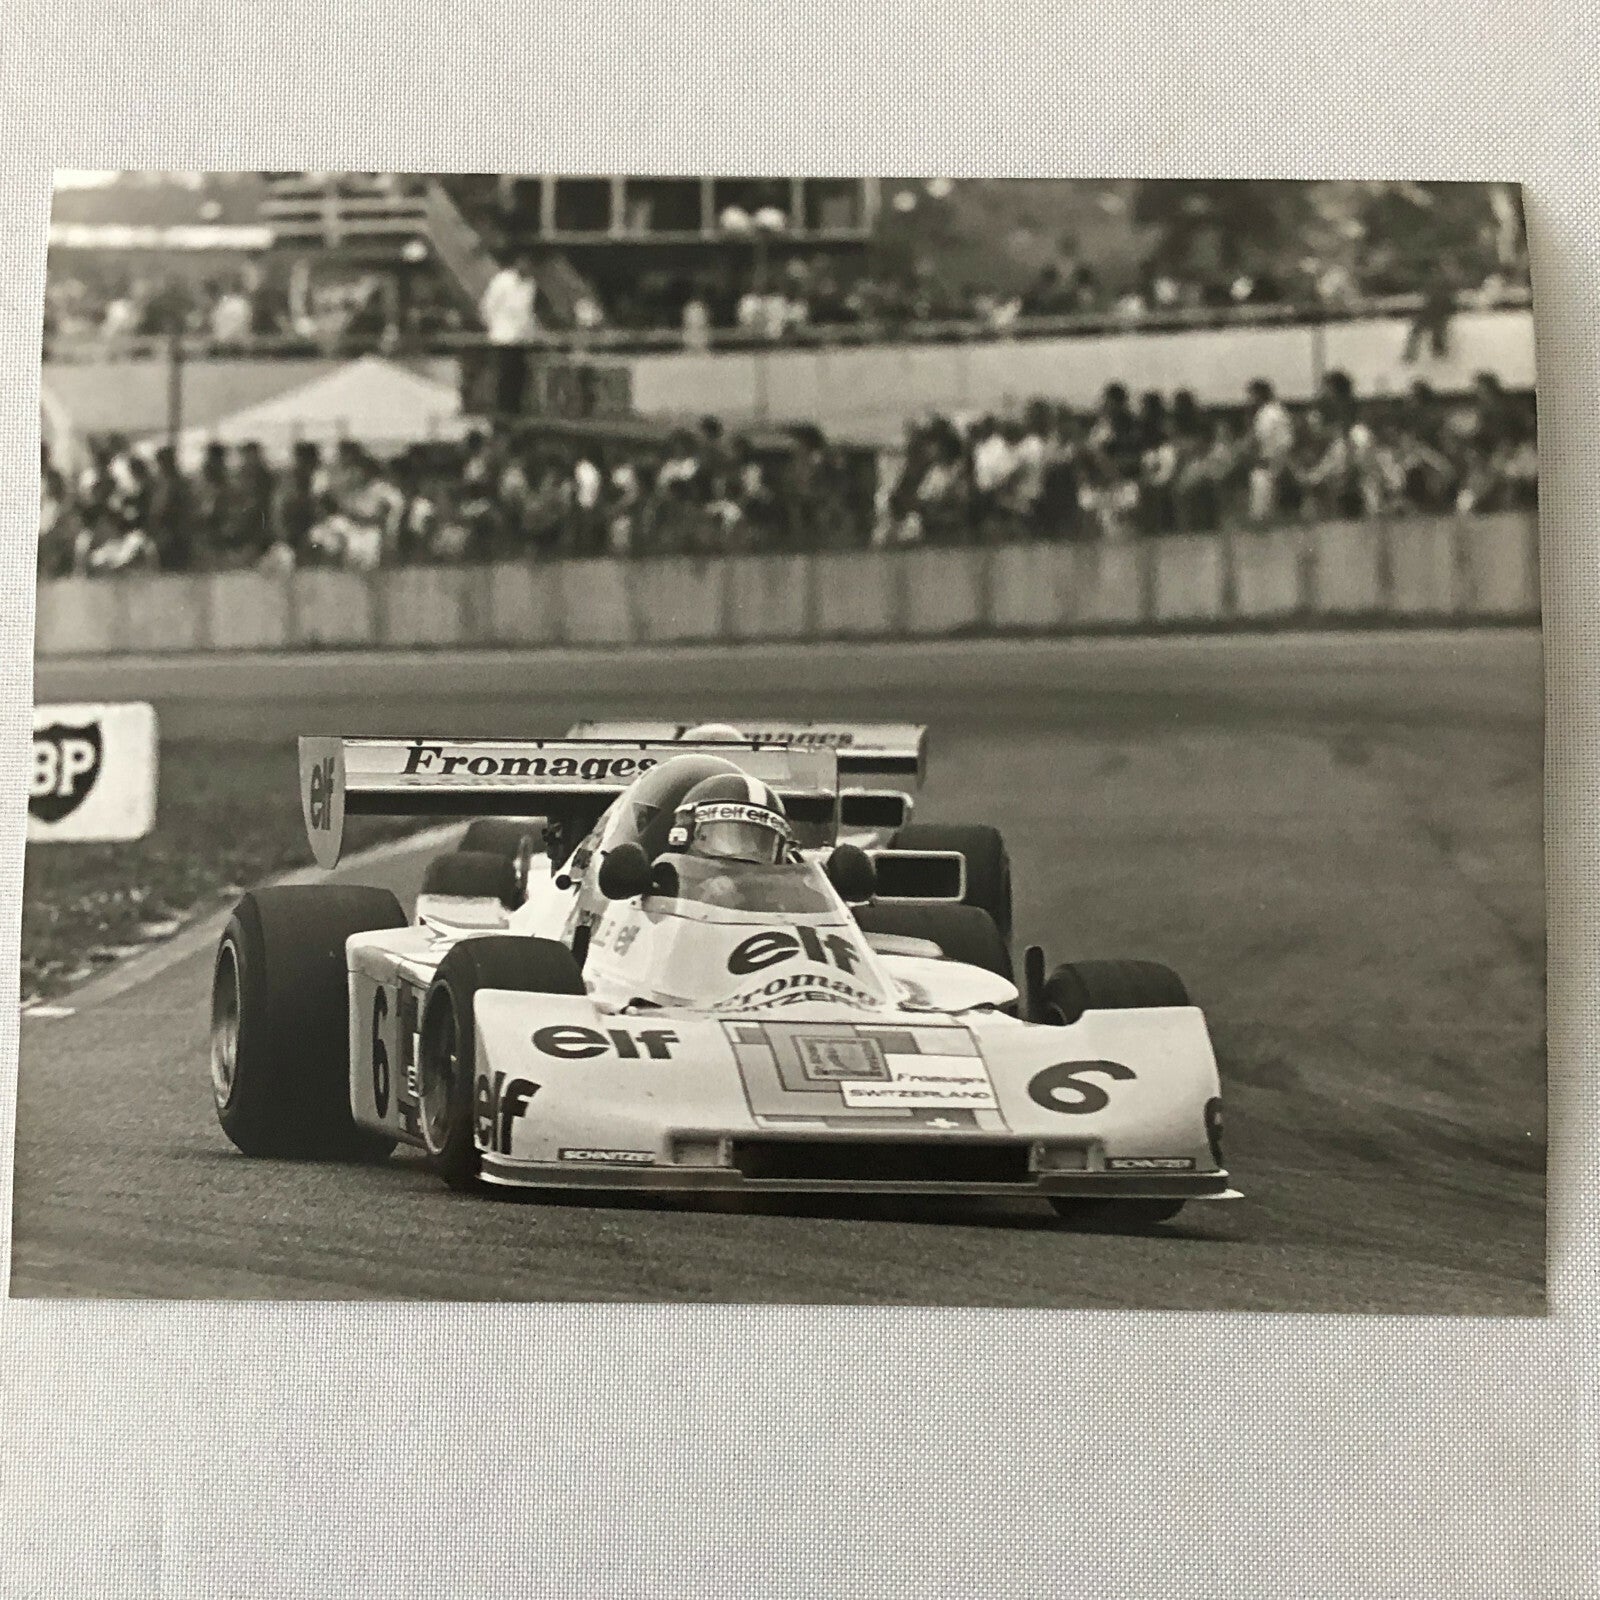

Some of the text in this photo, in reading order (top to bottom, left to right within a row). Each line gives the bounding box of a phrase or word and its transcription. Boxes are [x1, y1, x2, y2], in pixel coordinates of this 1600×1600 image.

[28, 738, 96, 798] BP
[310, 756, 335, 831] elf
[720, 806, 745, 819] elf
[727, 925, 860, 975] elf
[372, 985, 390, 1119] 6
[531, 1025, 680, 1060] elf
[474, 1070, 542, 1155] elf
[1027, 1060, 1137, 1115] 6
